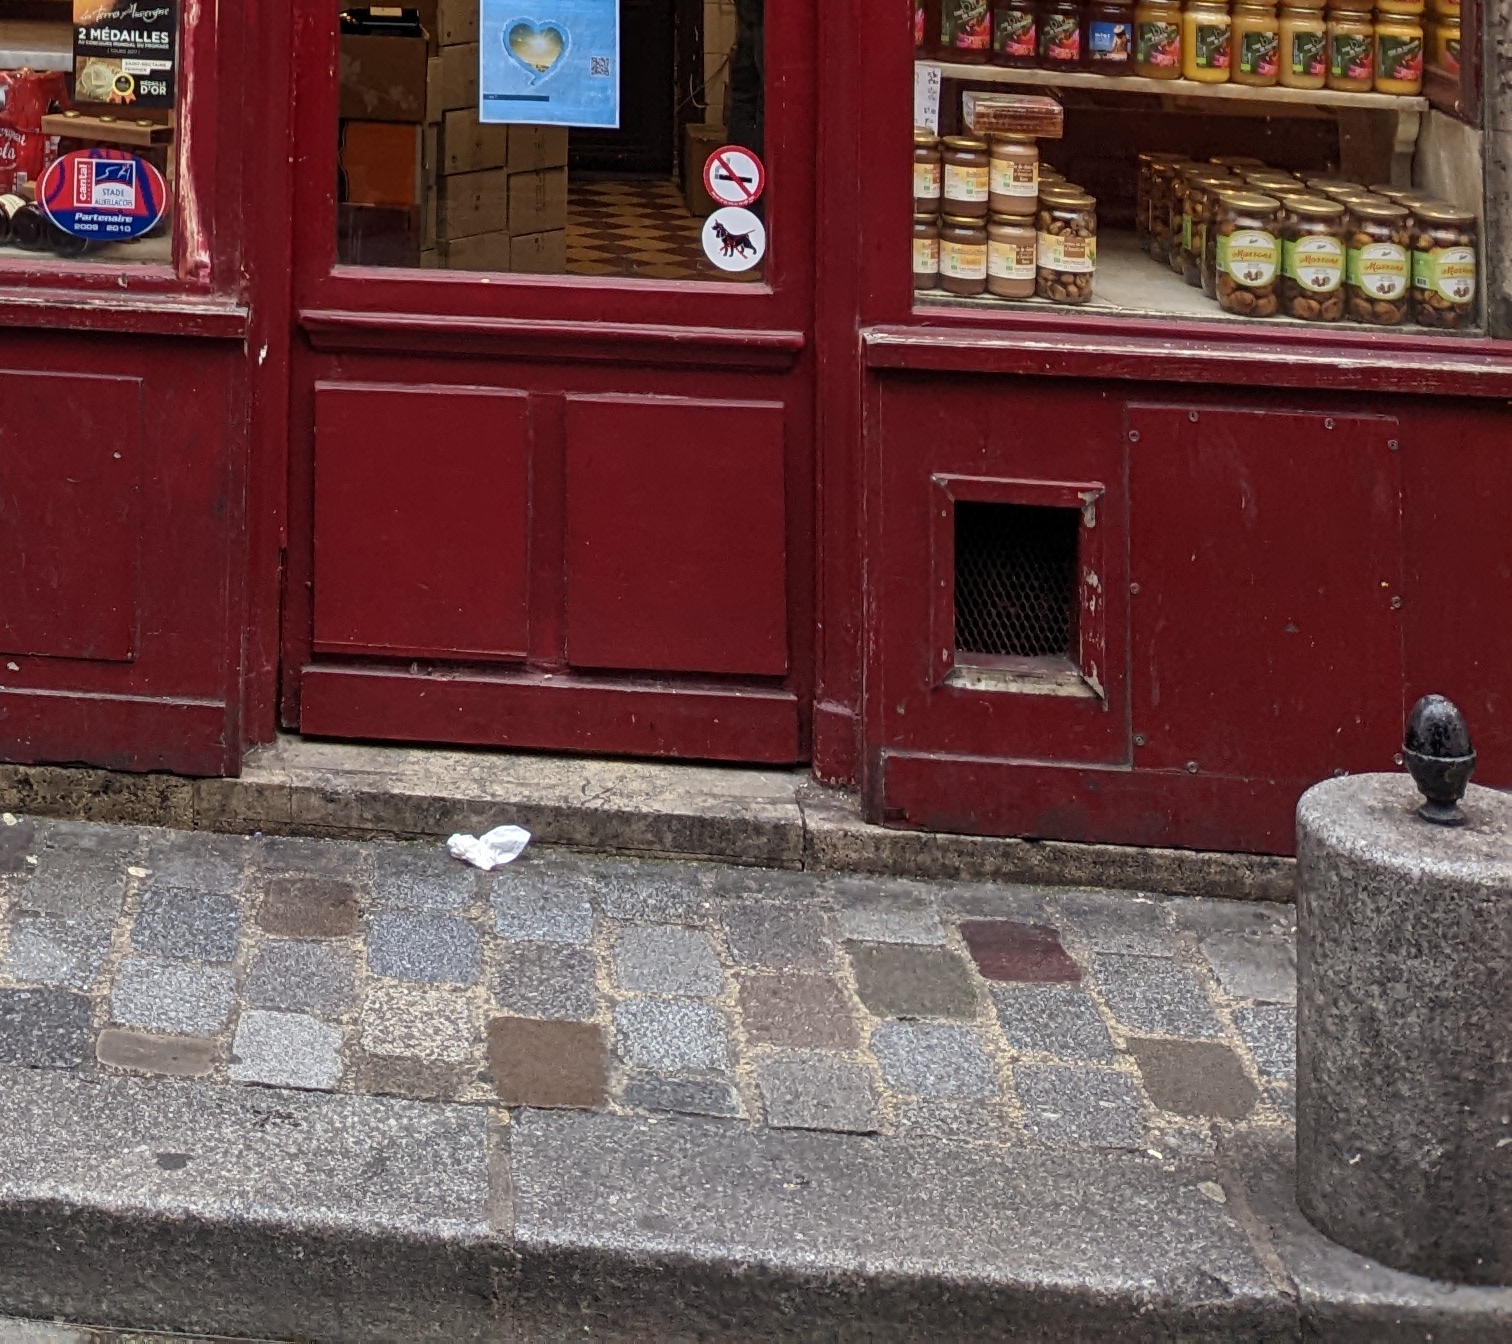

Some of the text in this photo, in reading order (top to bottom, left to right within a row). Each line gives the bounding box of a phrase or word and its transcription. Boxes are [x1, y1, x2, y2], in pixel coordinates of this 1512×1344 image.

[78, 27, 169, 44] 2 MÉDAILLES
[140, 85, 167, 95] D'OR
[78, 164, 88, 201] cantal
[102, 188, 125, 197] STADE
[74, 212, 133, 223] Partenaire
